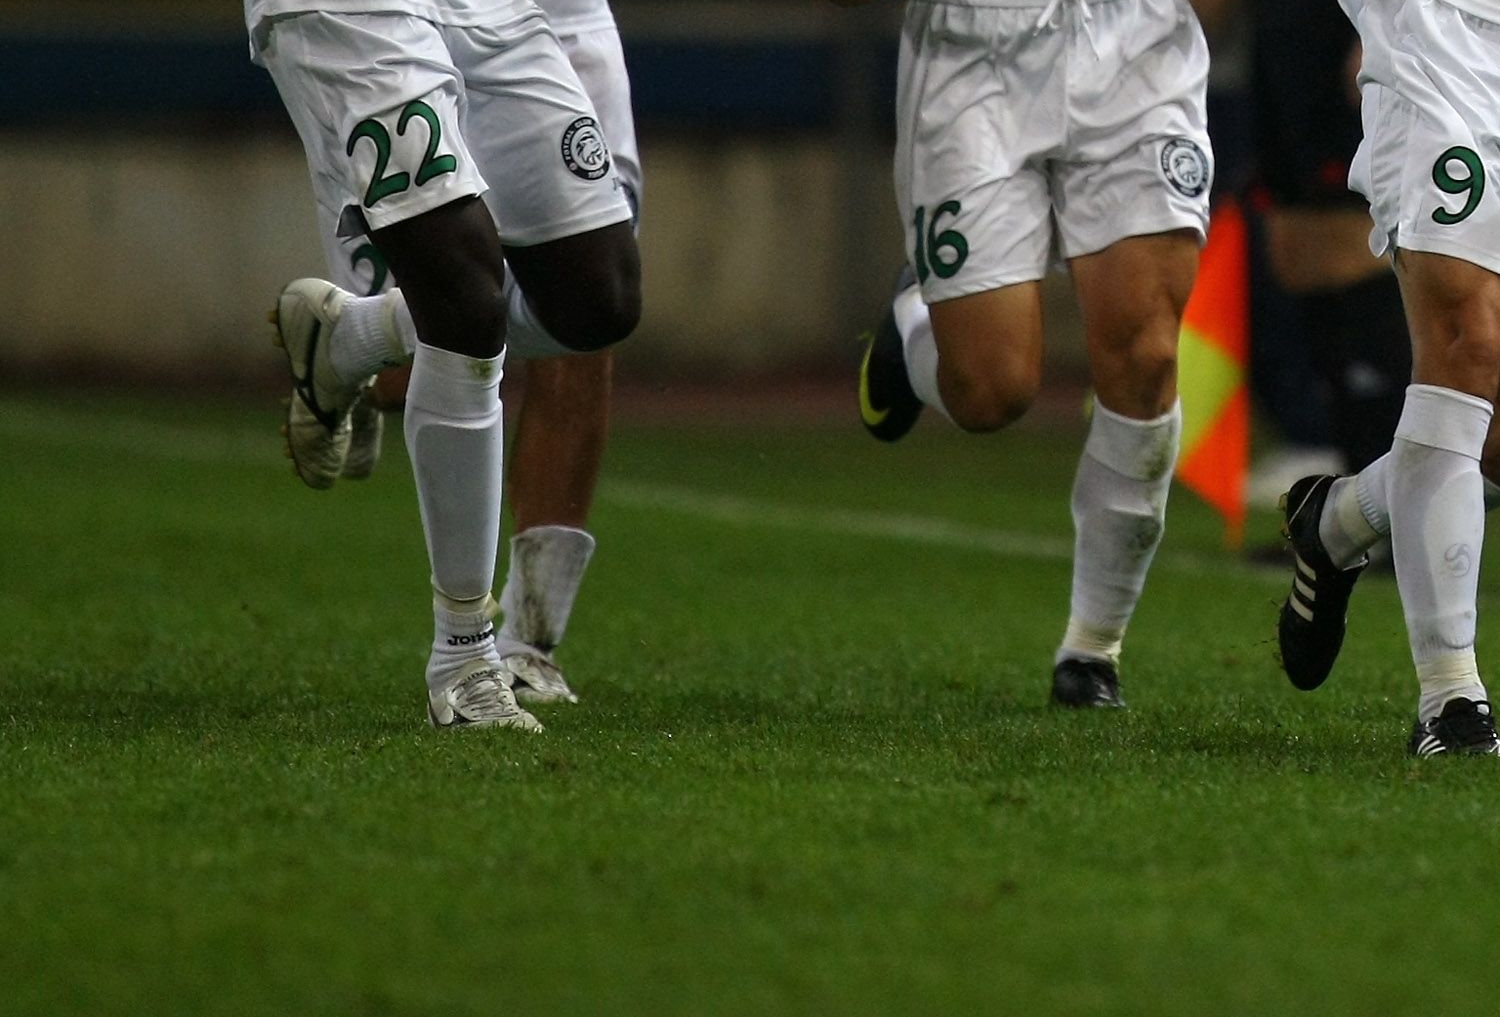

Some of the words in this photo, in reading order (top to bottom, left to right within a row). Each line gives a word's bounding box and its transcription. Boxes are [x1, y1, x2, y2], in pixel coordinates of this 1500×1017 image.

[346, 99, 457, 208] 22
[1431, 145, 1486, 225] 9
[913, 200, 969, 284] 16
